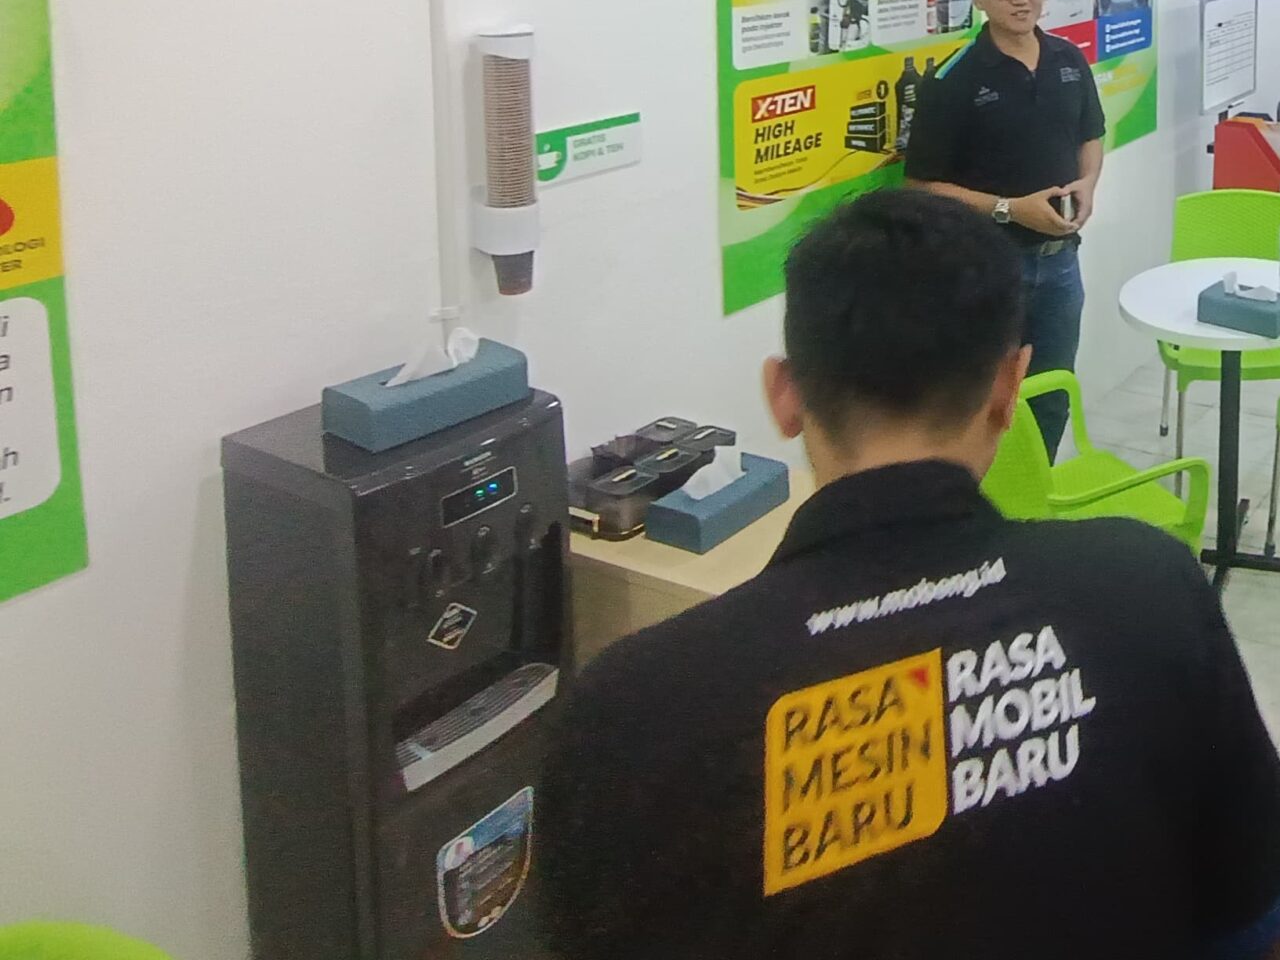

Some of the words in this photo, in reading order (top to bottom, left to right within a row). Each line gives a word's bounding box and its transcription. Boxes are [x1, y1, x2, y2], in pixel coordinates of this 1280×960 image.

[753, 88, 814, 121] X-TEN
[754, 119, 796, 144] HIGH
[753, 132, 823, 165] MILEAGE
[947, 625, 1067, 702] RASA
[783, 671, 906, 753] RASA
[950, 667, 1097, 758] MOBIL
[781, 718, 932, 814] MESIN
[951, 722, 1081, 816] BARU
[780, 784, 915, 876] BARU
